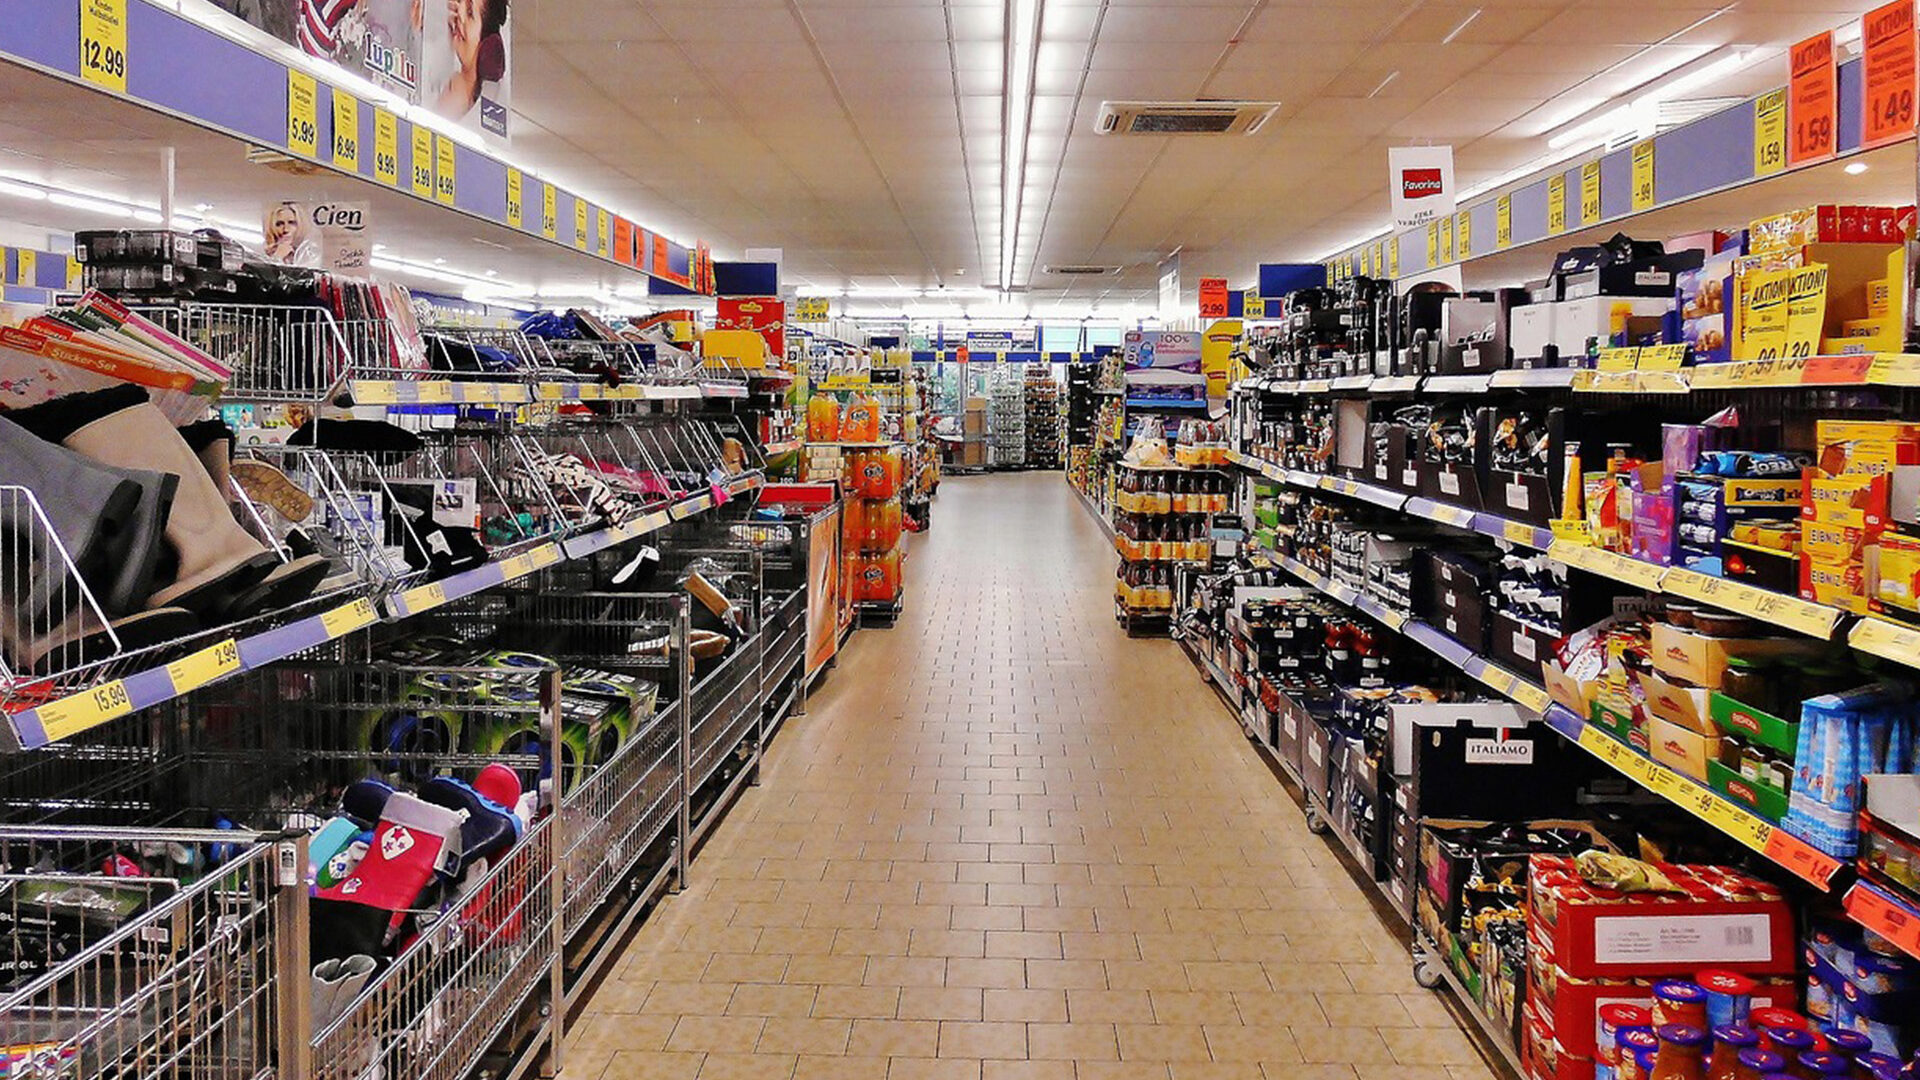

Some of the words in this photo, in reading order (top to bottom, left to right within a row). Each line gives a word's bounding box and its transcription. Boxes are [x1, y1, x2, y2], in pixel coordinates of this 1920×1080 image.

[84, 37, 124, 78] 12.99
[364, 32, 416, 83] lupilu
[1872, 89, 1912, 131] 1.49
[291, 117, 315, 145] 5.99
[1797, 115, 1831, 153] 1.59
[337, 135, 355, 161] 6.99
[1760, 141, 1780, 167] 1.59
[376, 152, 394, 176] 9.99
[415, 165, 430, 188] 3.99
[438, 175, 453, 196] 4.99
[1403, 180, 1442, 190] Favorina
[313, 205, 362, 226] Cien
[1203, 303, 1224, 314] 2.99
[1161, 334, 1190, 343] 100%
[51, 348, 118, 371] Sticker-Set
[1778, 341, 1810, 371] 1.39
[215, 643, 238, 667] 2.99
[93, 684, 128, 713] 15.99
[1471, 745, 1528, 755] ITALIAMO
[1750, 823, 1771, 844] -.99
